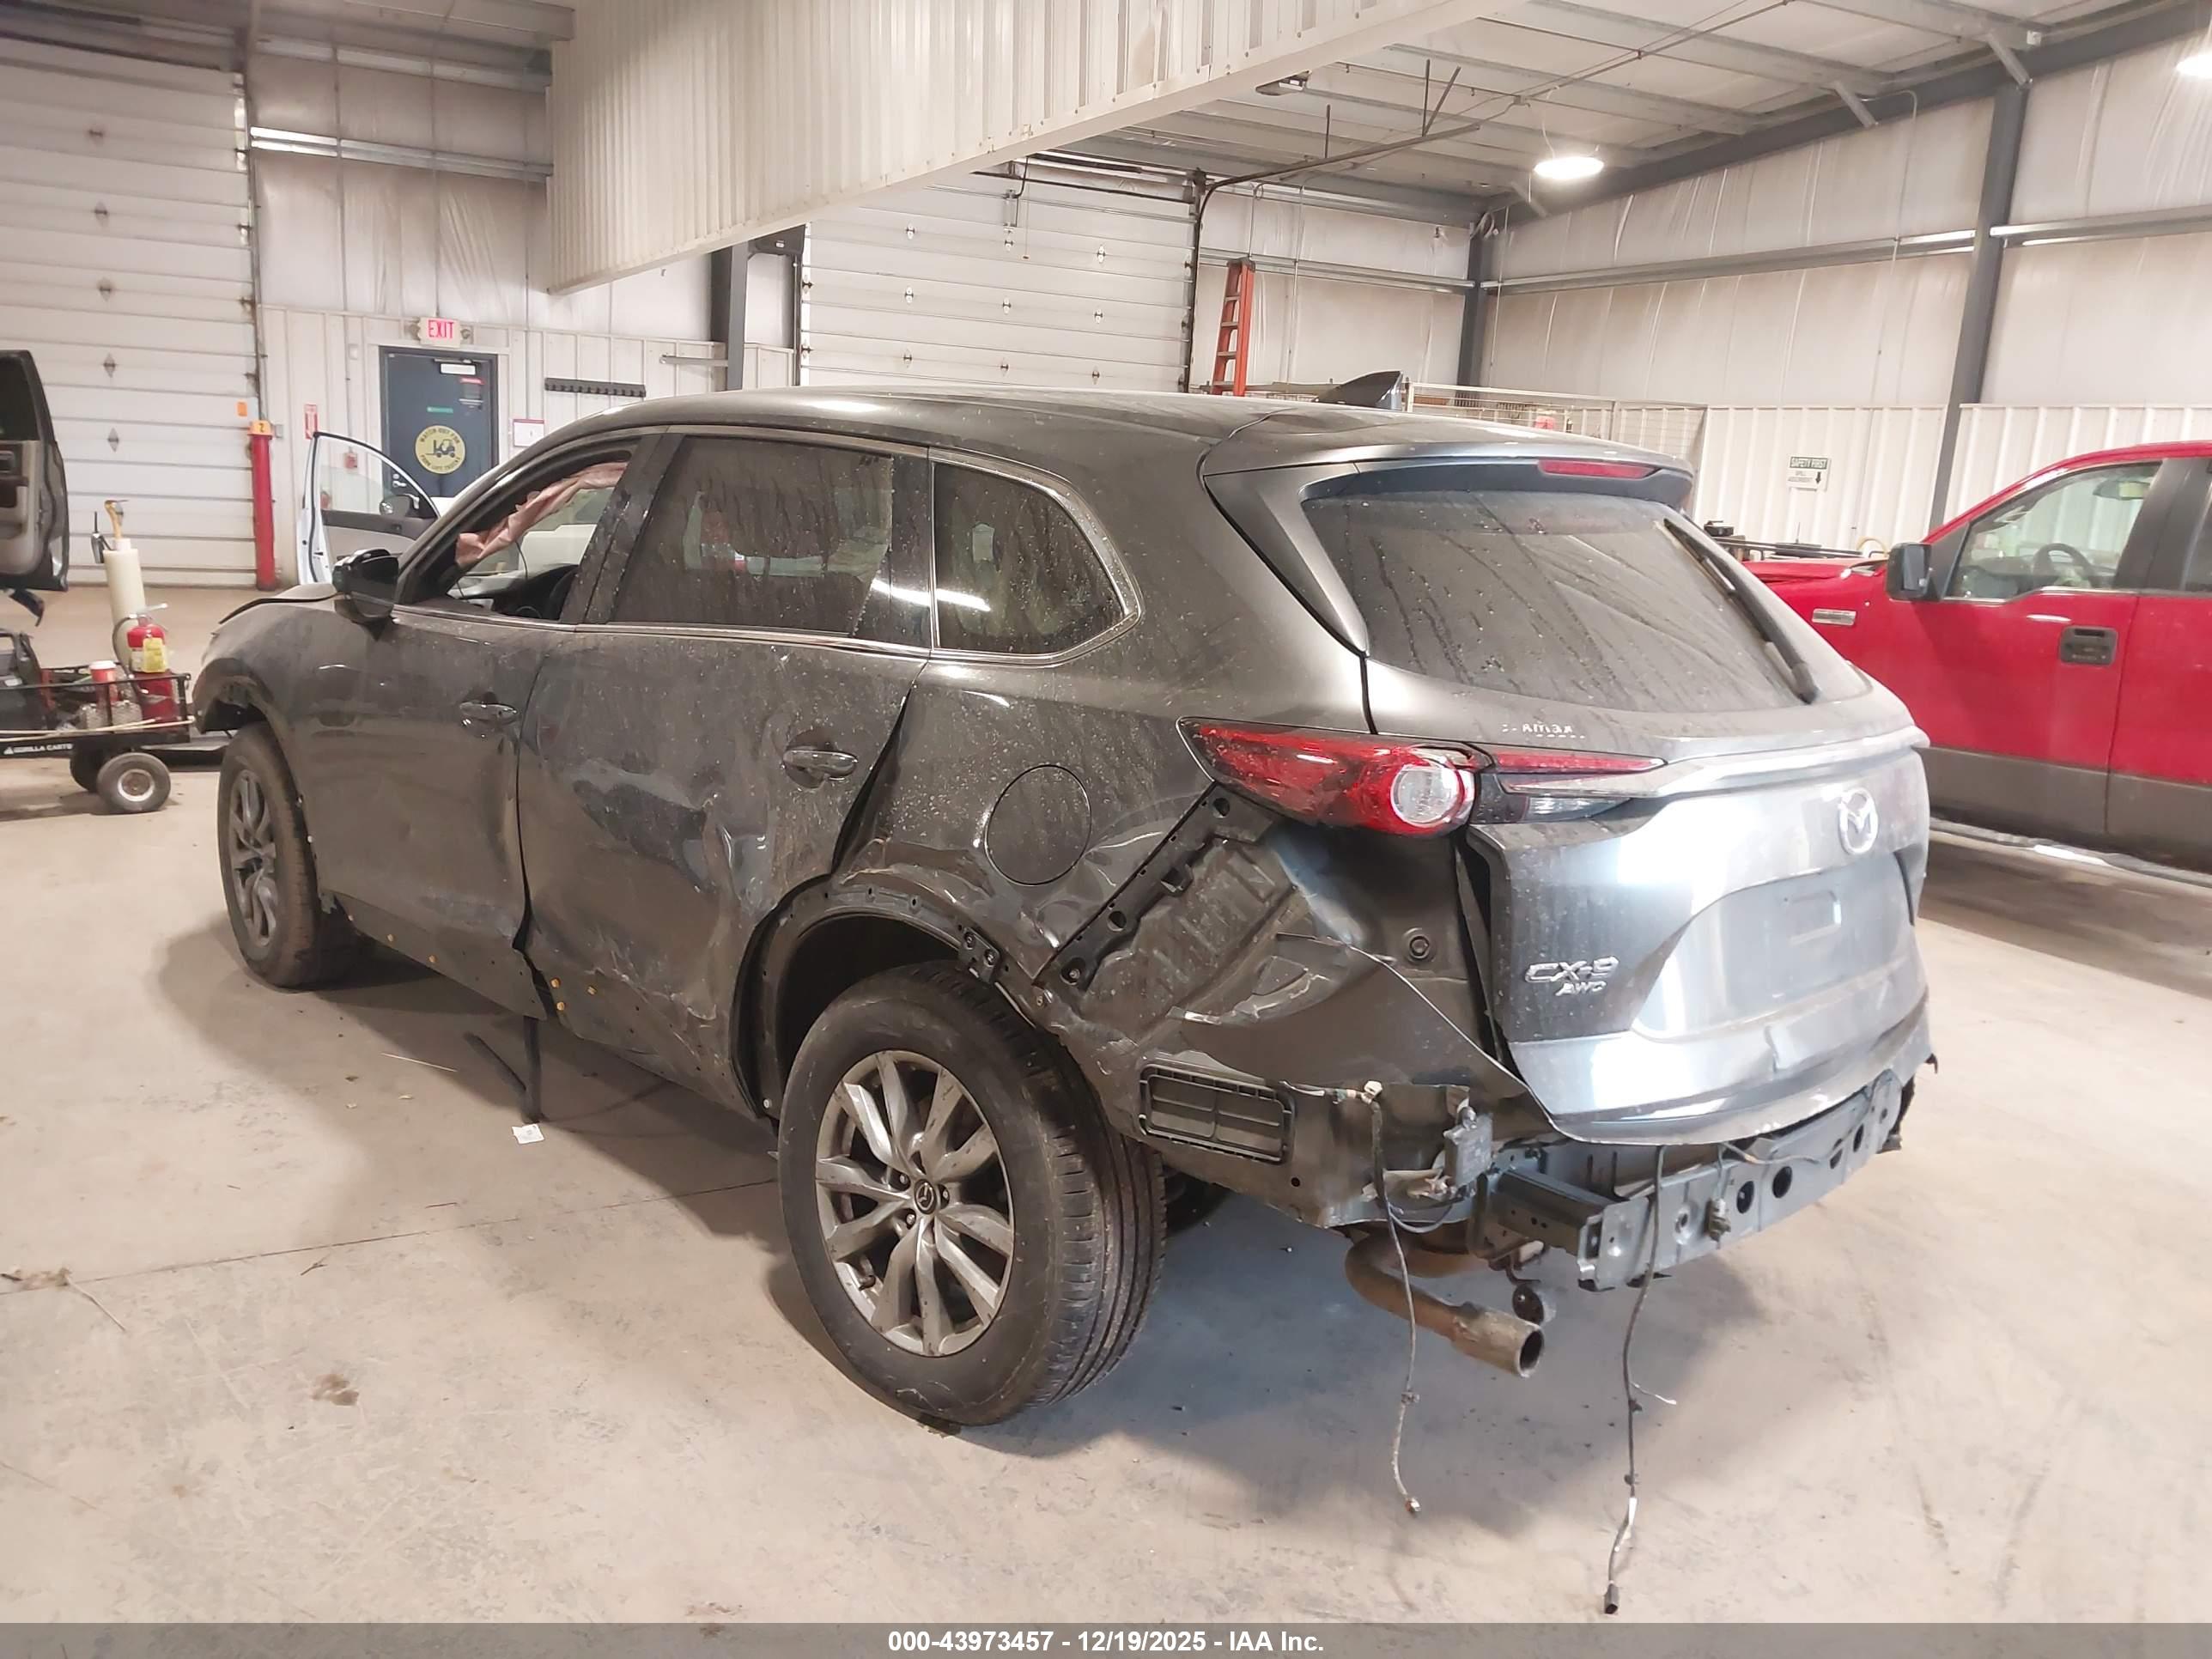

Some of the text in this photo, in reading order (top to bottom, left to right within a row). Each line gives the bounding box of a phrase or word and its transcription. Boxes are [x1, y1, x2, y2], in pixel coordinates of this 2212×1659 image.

[428, 319, 454, 339] EXIT
[1791, 457, 1827, 469] SAFETY FIRST
[1524, 956, 1620, 983] CX-9
[1554, 980, 1608, 997] AWD
